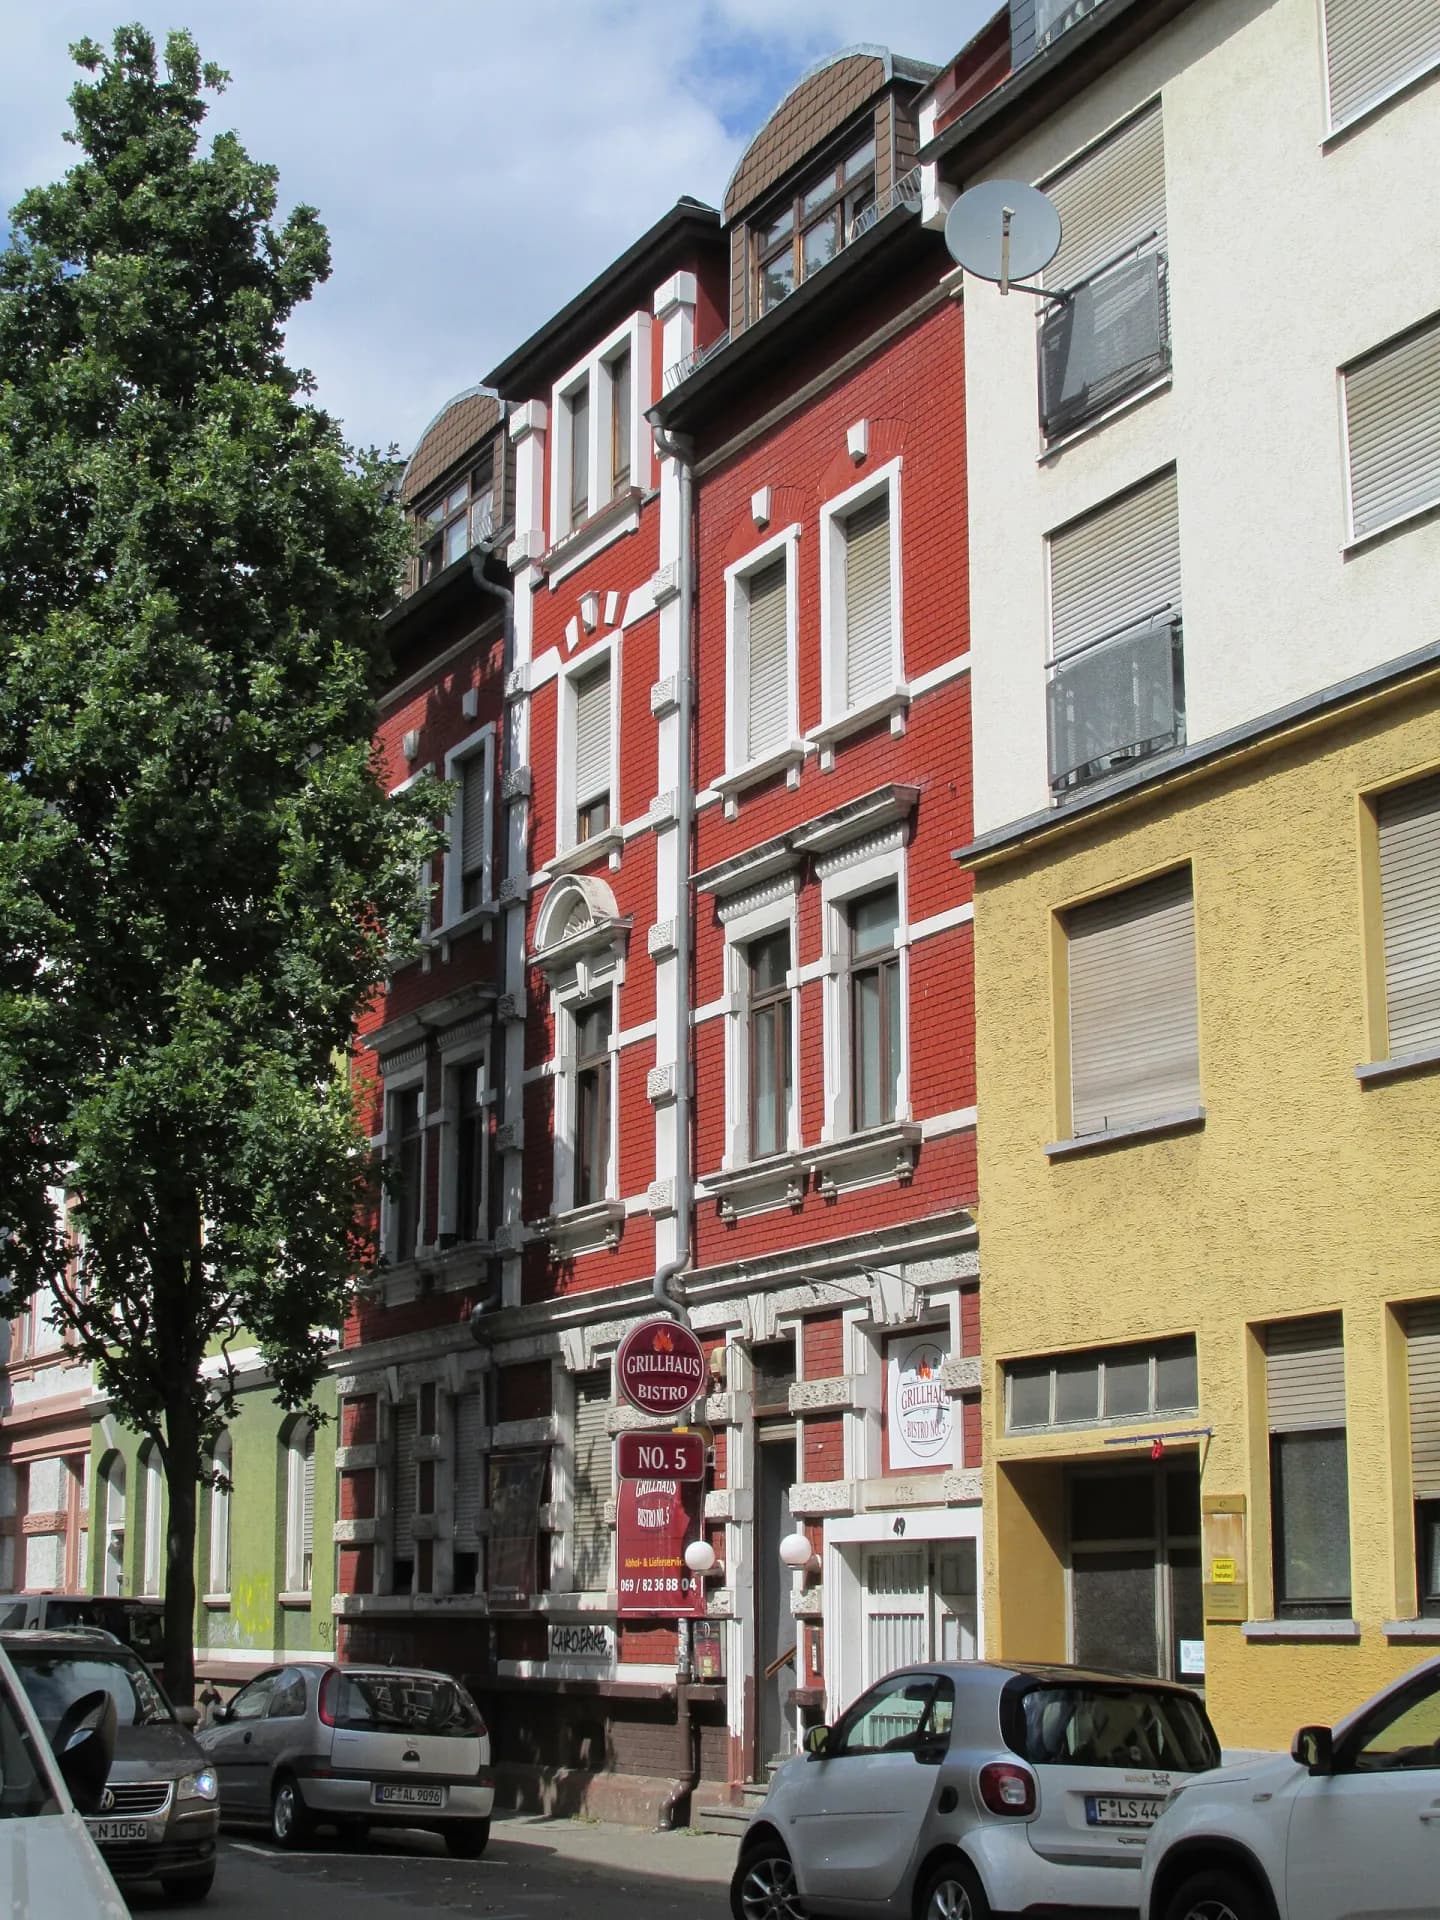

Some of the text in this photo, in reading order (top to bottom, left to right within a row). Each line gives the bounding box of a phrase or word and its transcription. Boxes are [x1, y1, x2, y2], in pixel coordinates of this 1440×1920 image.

[627, 1354, 700, 1376] GRILLHAUS
[638, 1384, 688, 1400] BISTRO
[907, 1420, 928, 1438] BISTRO
[638, 1446, 687, 1470] NO. 5
[635, 1480, 677, 1498] GRILLHAUS
[637, 1507, 656, 1528] BISTRO
[620, 1578, 634, 1592] 069
[642, 1578, 653, 1592] 82
[654, 1578, 664, 1592] 36
[665, 1578, 678, 1592] 88
[681, 1578, 697, 1592] 04
[384, 1787, 397, 1799] OF
[417, 1790, 440, 1801] 9096
[1098, 1800, 1107, 1817] F
[1118, 1800, 1138, 1818] LS
[98, 1823, 146, 1838] N 1056
